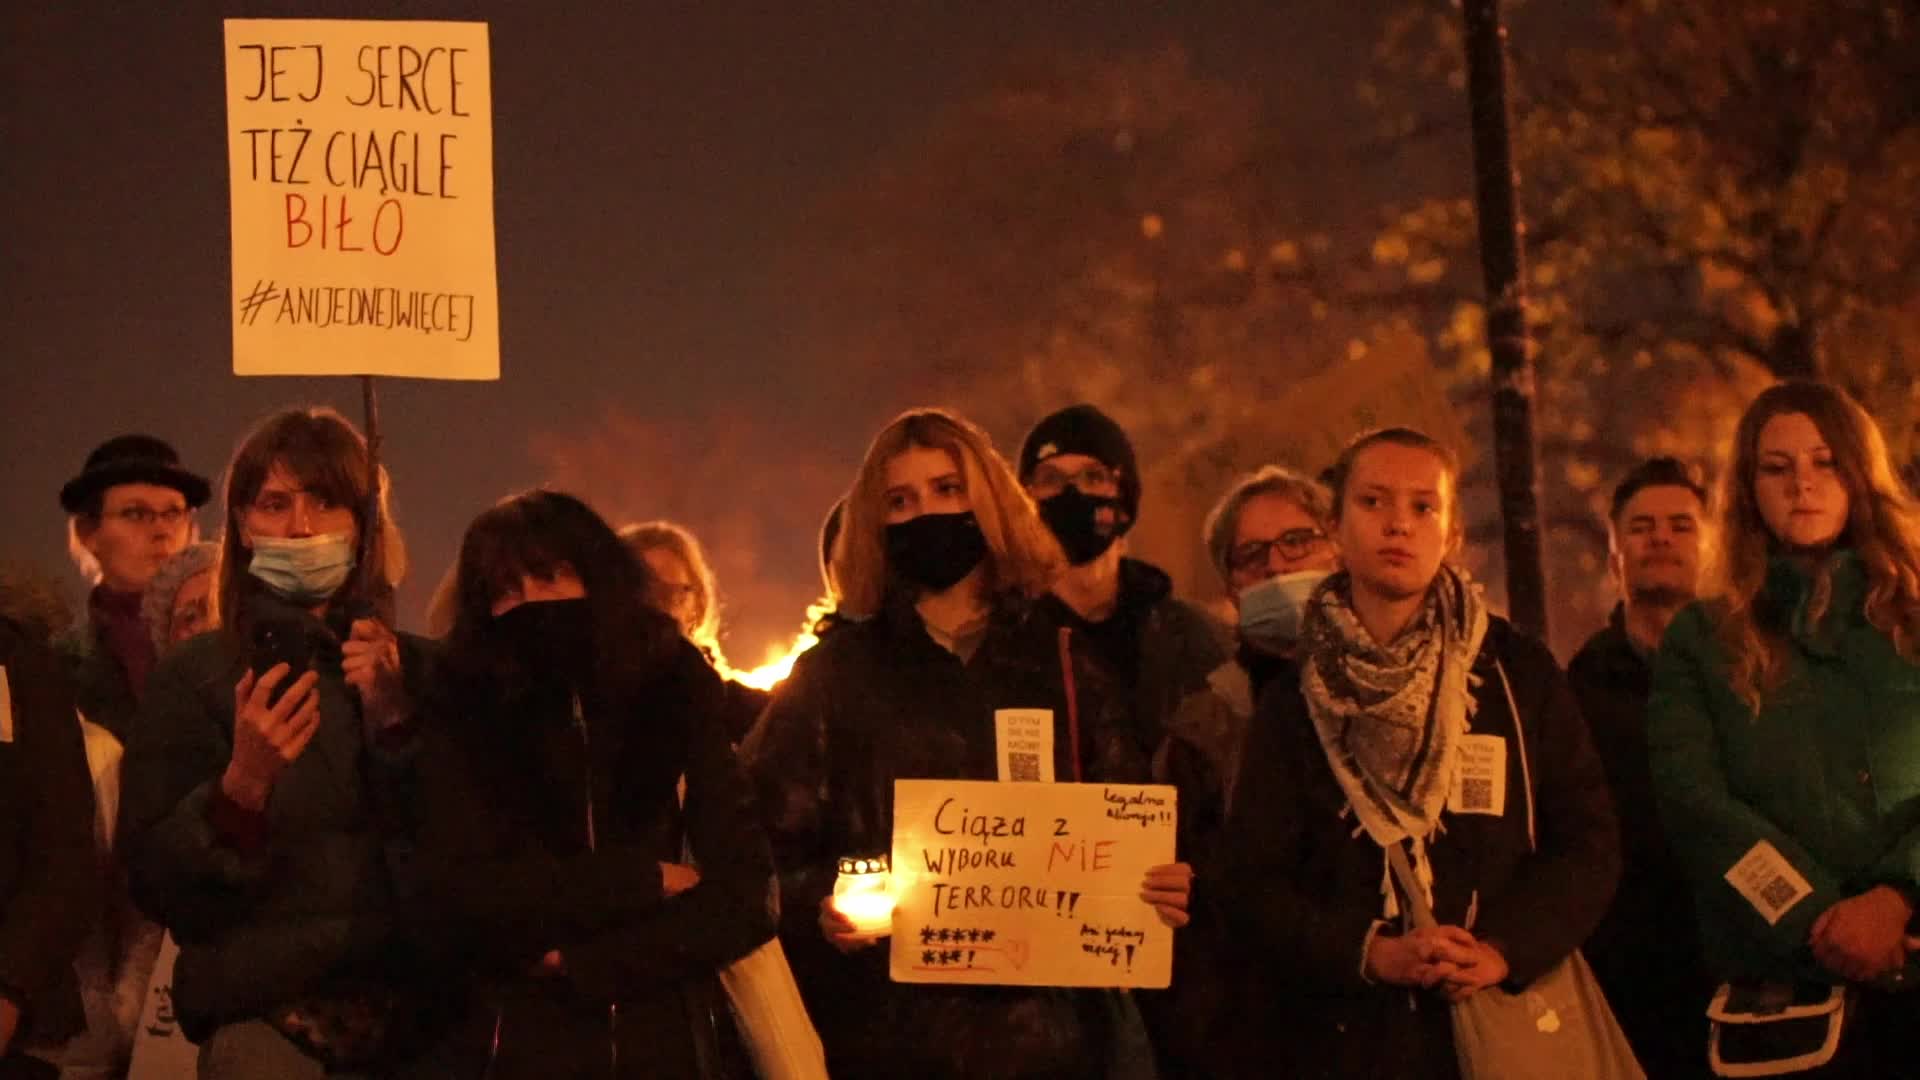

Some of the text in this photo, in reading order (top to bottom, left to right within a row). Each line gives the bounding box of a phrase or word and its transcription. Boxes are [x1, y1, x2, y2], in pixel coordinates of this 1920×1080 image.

[238, 44, 470, 117] JEJ SERCE
[241, 118, 458, 199] TEŻ CIĄGLE
[285, 193, 404, 256] BIŁO
[239, 279, 475, 342] #ANIJEDNEJWIĘCEJ
